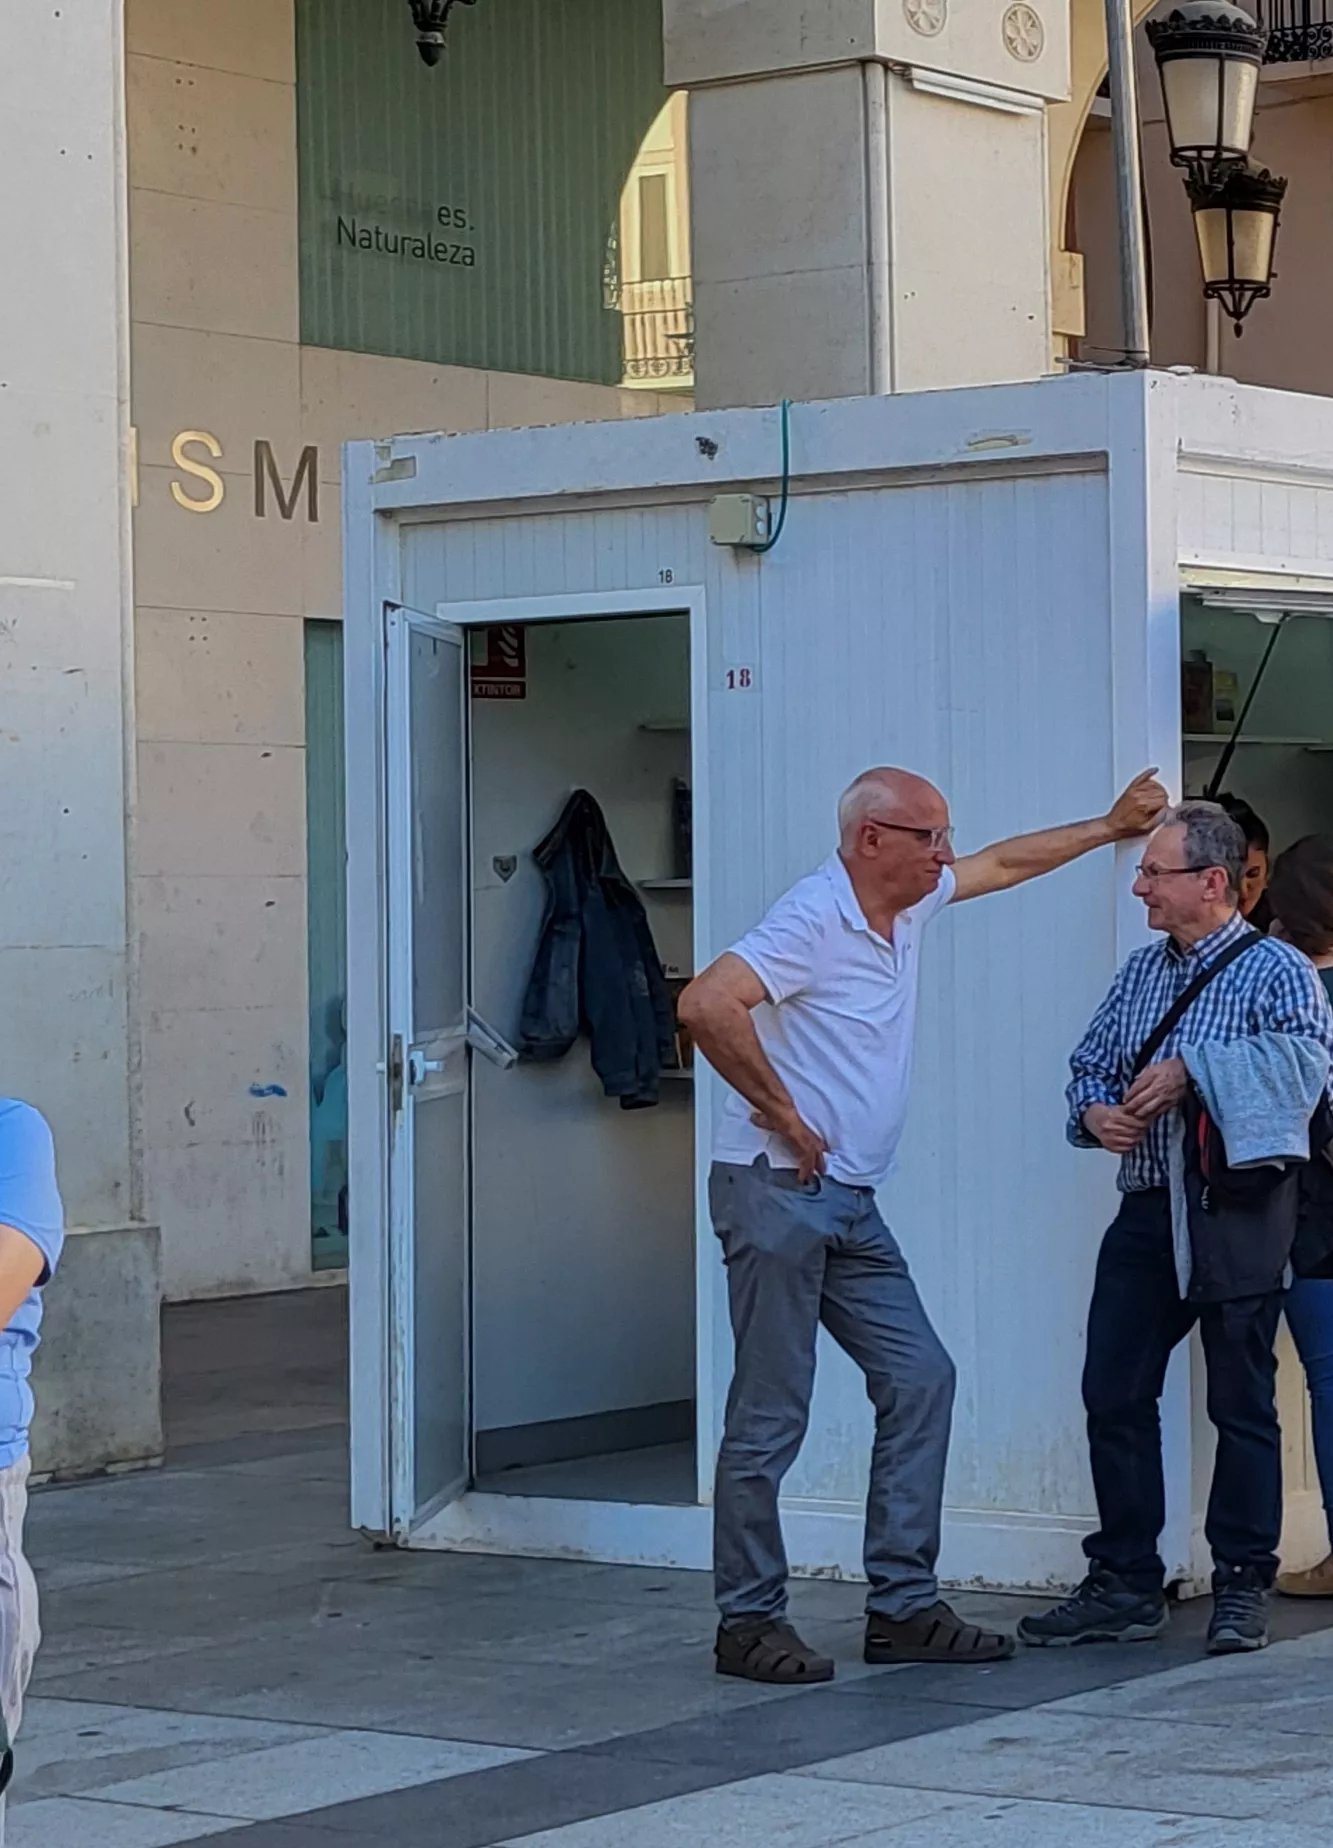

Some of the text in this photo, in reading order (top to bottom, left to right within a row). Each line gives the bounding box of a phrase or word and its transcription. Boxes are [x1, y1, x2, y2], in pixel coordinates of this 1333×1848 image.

[337, 215, 476, 266] Naturaleza
[658, 568, 673, 584] 18
[726, 668, 752, 690] 18
